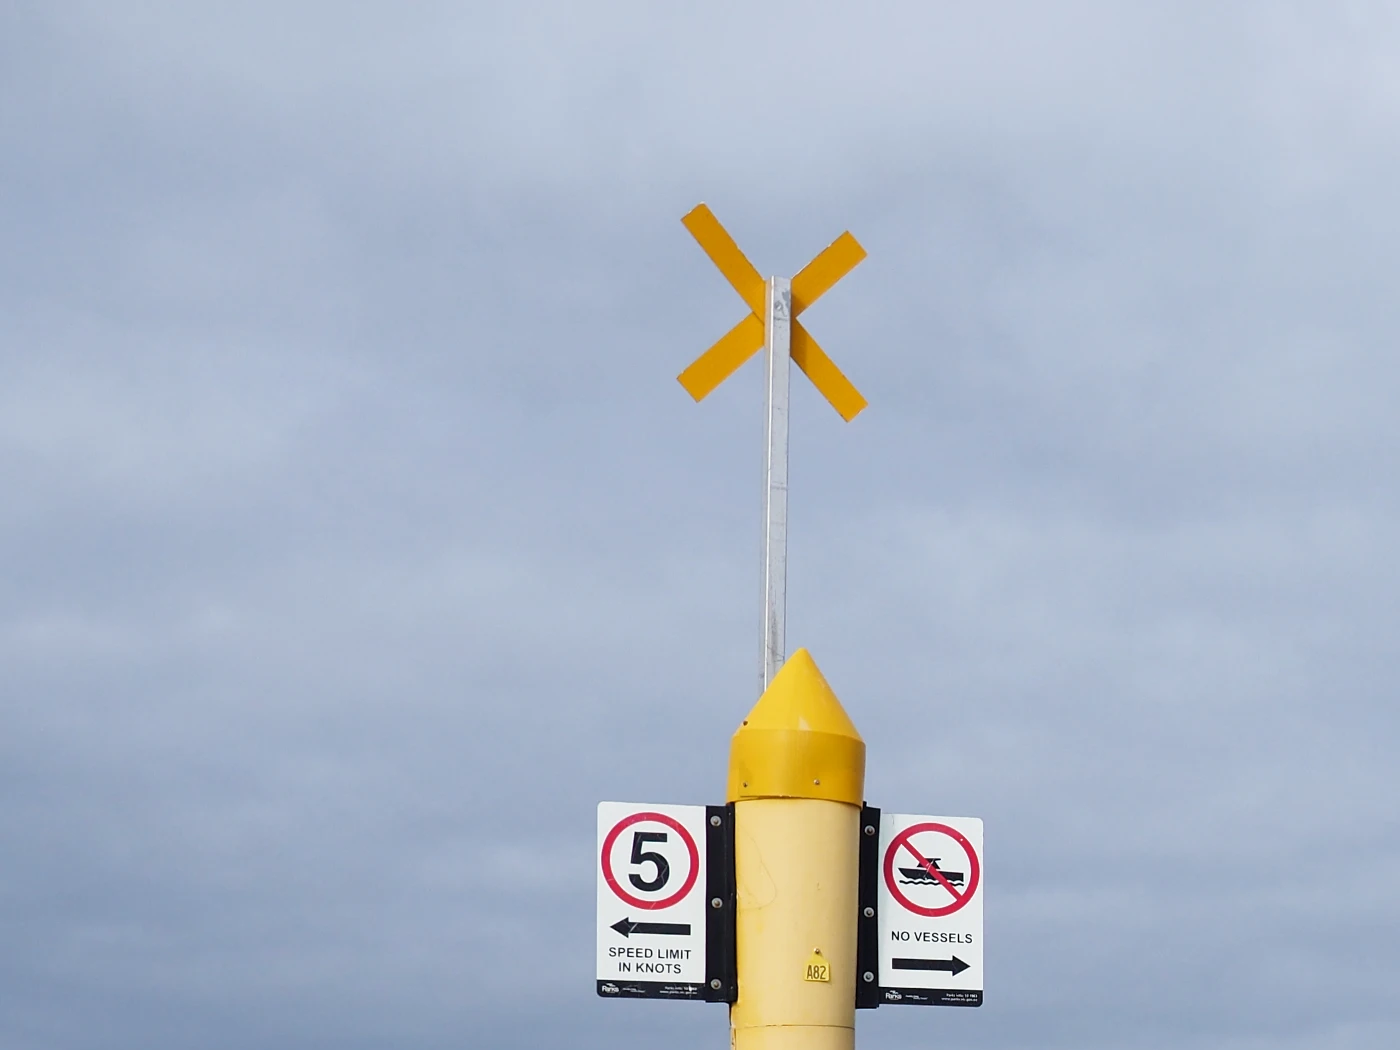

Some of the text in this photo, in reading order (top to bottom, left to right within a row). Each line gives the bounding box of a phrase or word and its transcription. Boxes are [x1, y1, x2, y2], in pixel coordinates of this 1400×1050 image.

[628, 831, 670, 892] 5
[891, 931, 973, 944] NO VESSELS
[608, 947, 692, 960] SPEED LIMIT
[618, 962, 682, 974] IN KNOTS
[806, 964, 827, 980] A82
